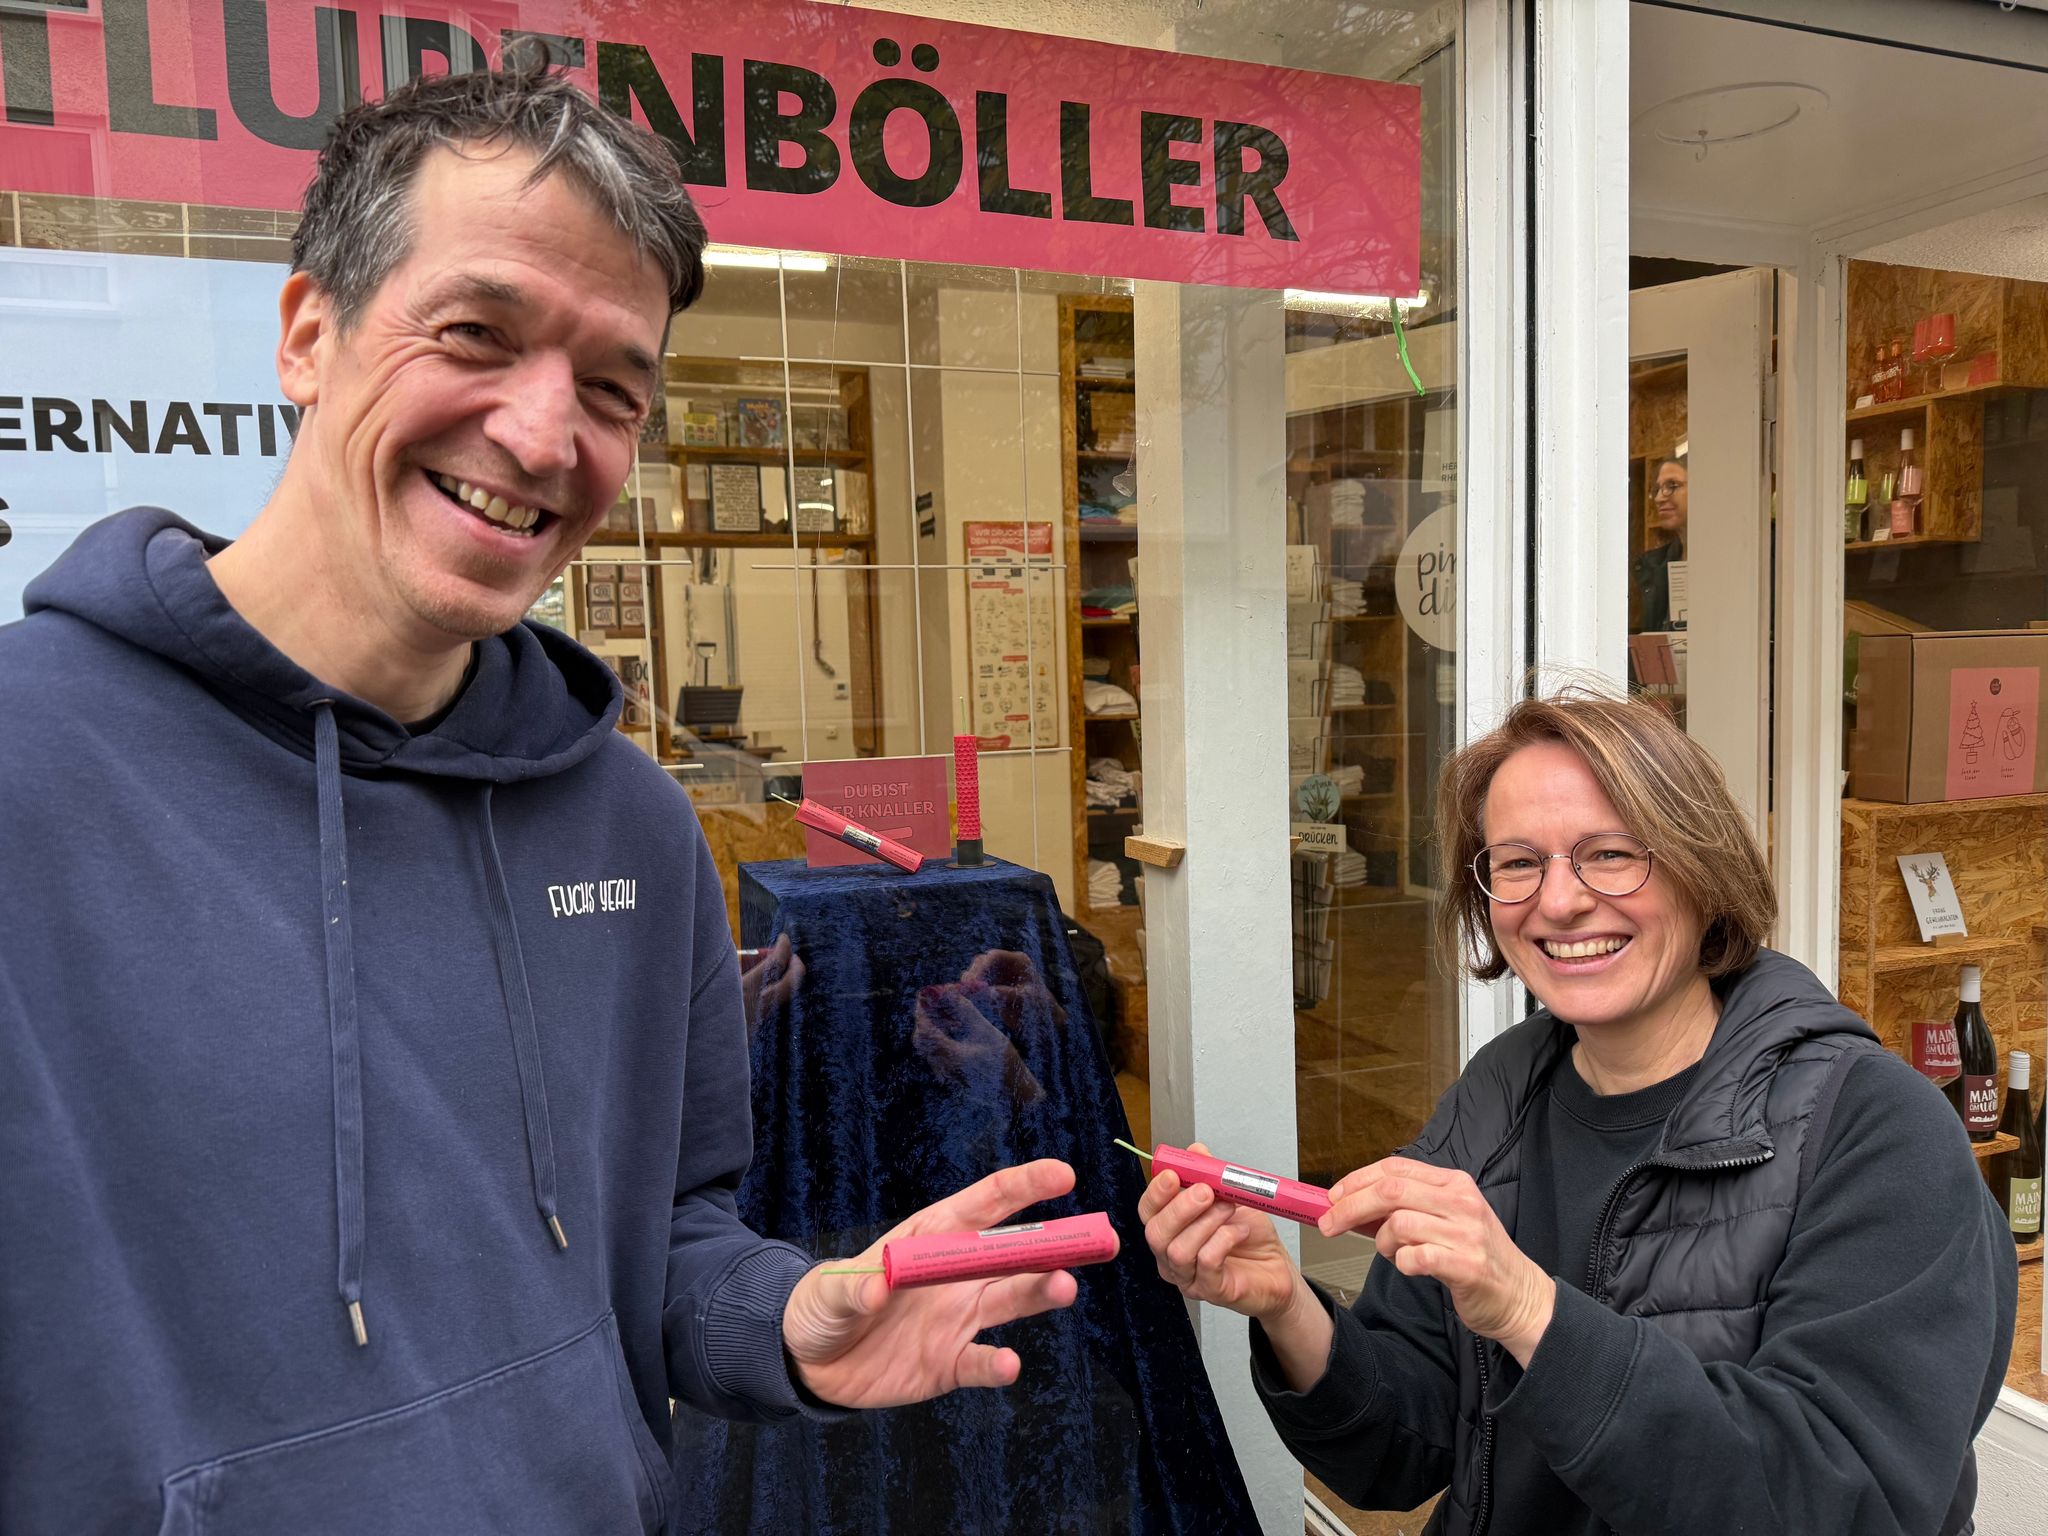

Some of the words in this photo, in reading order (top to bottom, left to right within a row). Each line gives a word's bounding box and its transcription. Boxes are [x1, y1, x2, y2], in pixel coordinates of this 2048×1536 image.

[990, 536, 1050, 545] WUNSCHOTIV
[991, 529, 1029, 537] DRUCKE
[1419, 577, 1457, 616] di
[844, 785, 869, 799] DU
[872, 782, 909, 797] BIST
[832, 805, 856, 818] ER
[859, 801, 935, 817] KNALLER
[548, 882, 595, 918] FUCHS
[599, 879, 636, 911] YEAH
